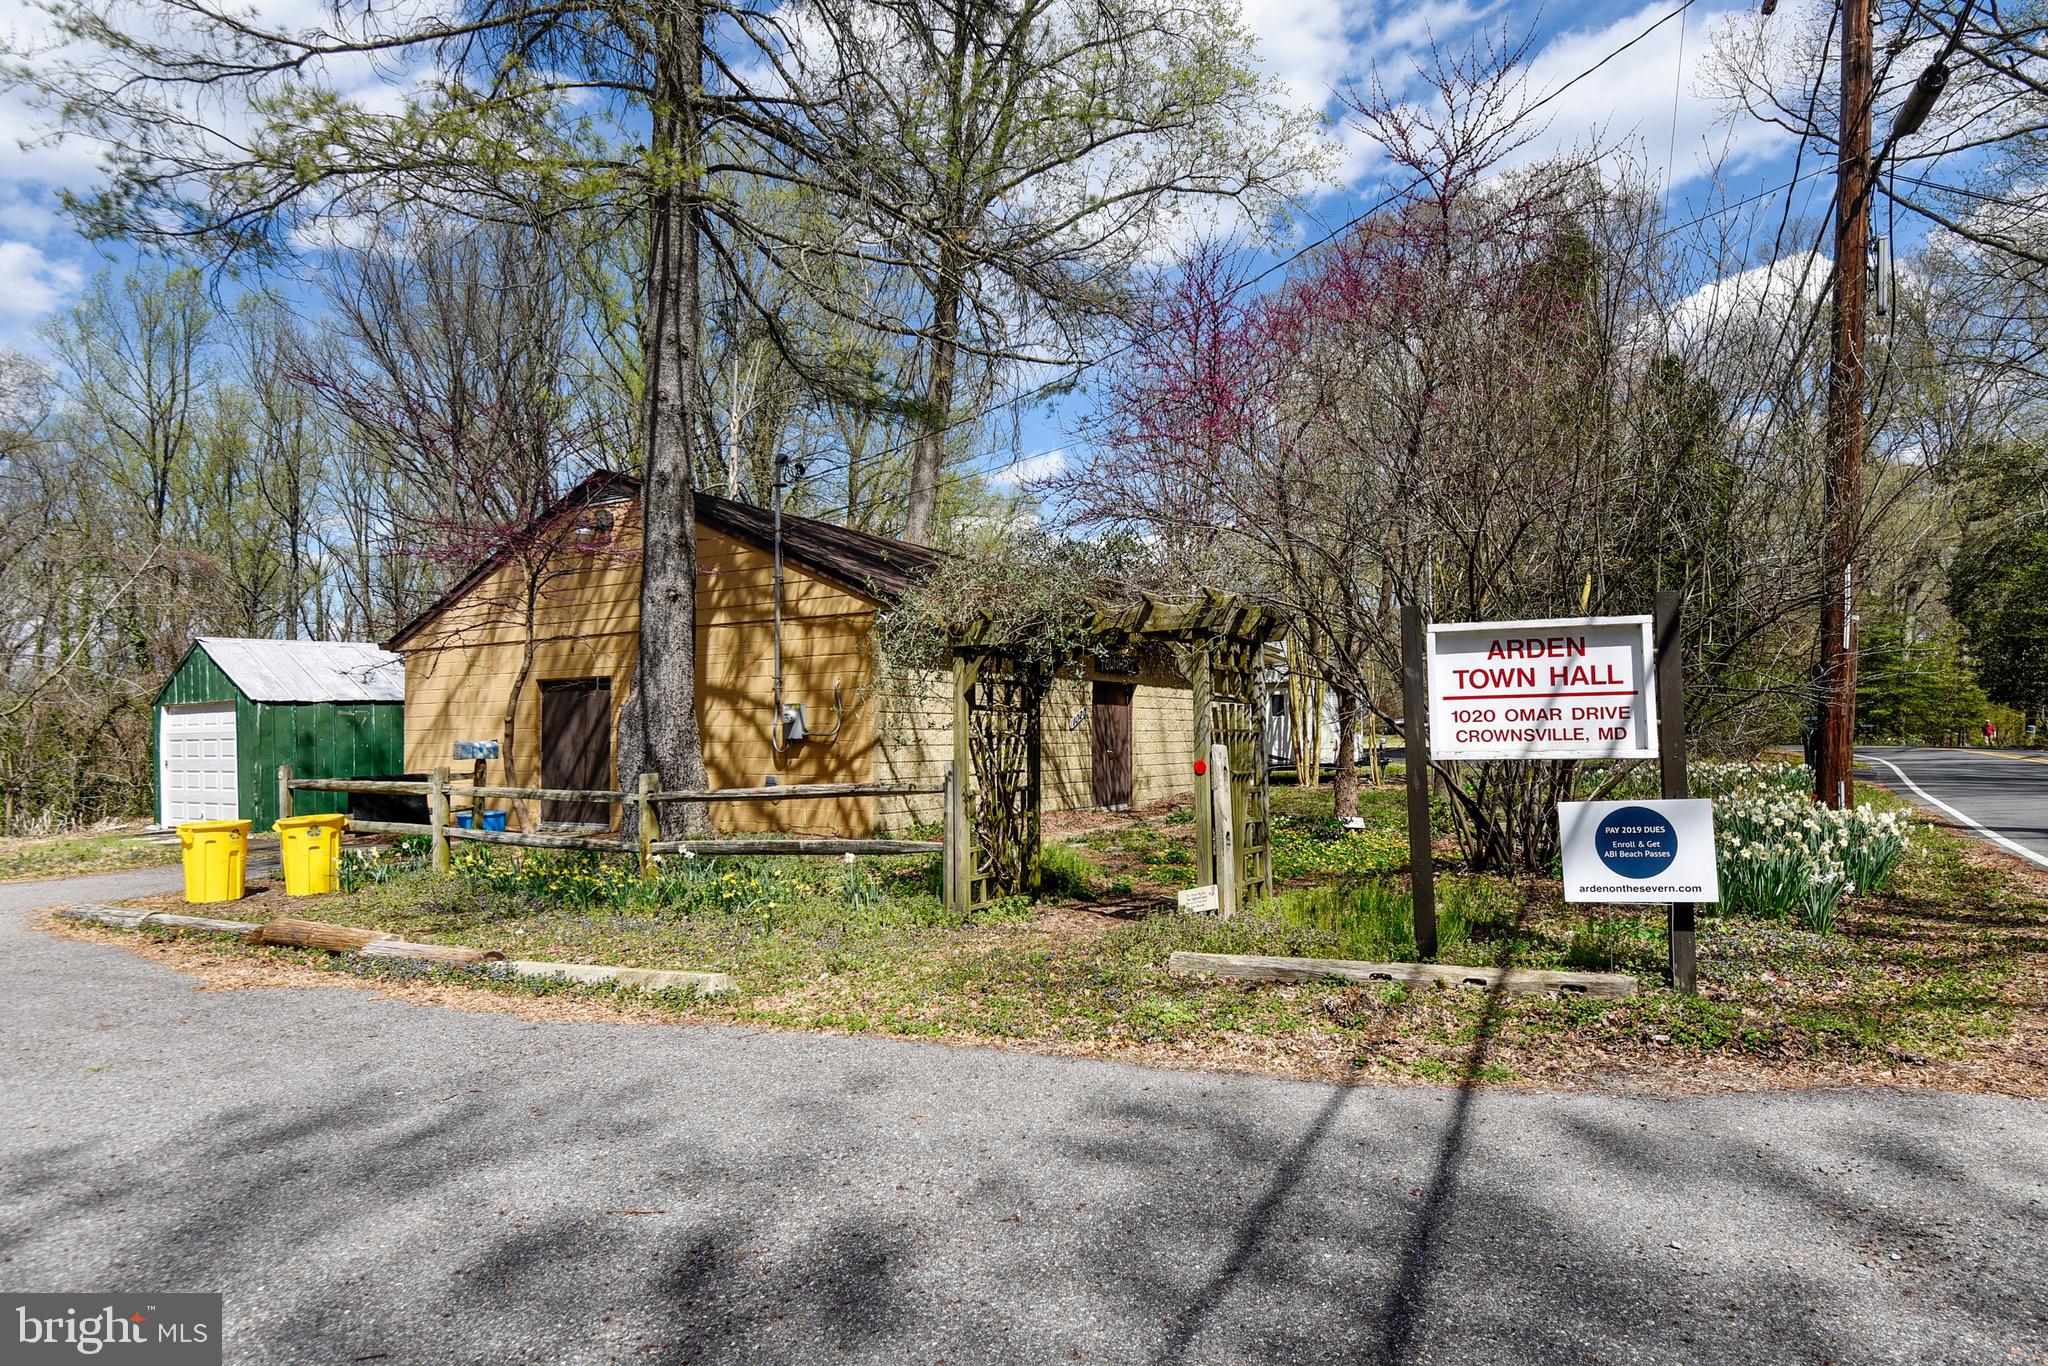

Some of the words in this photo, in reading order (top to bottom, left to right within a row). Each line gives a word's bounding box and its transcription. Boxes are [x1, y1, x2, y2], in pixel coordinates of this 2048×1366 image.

[1487, 636, 1586, 660] ARDEN
[1452, 667, 1536, 690] TOWN
[1549, 664, 1624, 687] HALL
[1450, 709, 1496, 723] 1020
[1504, 707, 1563, 722] OMAR
[1571, 706, 1631, 720] DRIVE
[1455, 727, 1590, 743] CROWNSVILLE,
[1598, 727, 1627, 740] MD
[1605, 826, 1620, 834] PAY
[1621, 826, 1642, 834] 2019
[1612, 840, 1636, 848] Enroll
[1646, 840, 1661, 848] Get
[1604, 850, 1618, 858] ABI
[1619, 850, 1643, 858] Beach
[1645, 850, 1671, 858] Passes
[1579, 884, 1702, 893] ardenonthesevern.com
